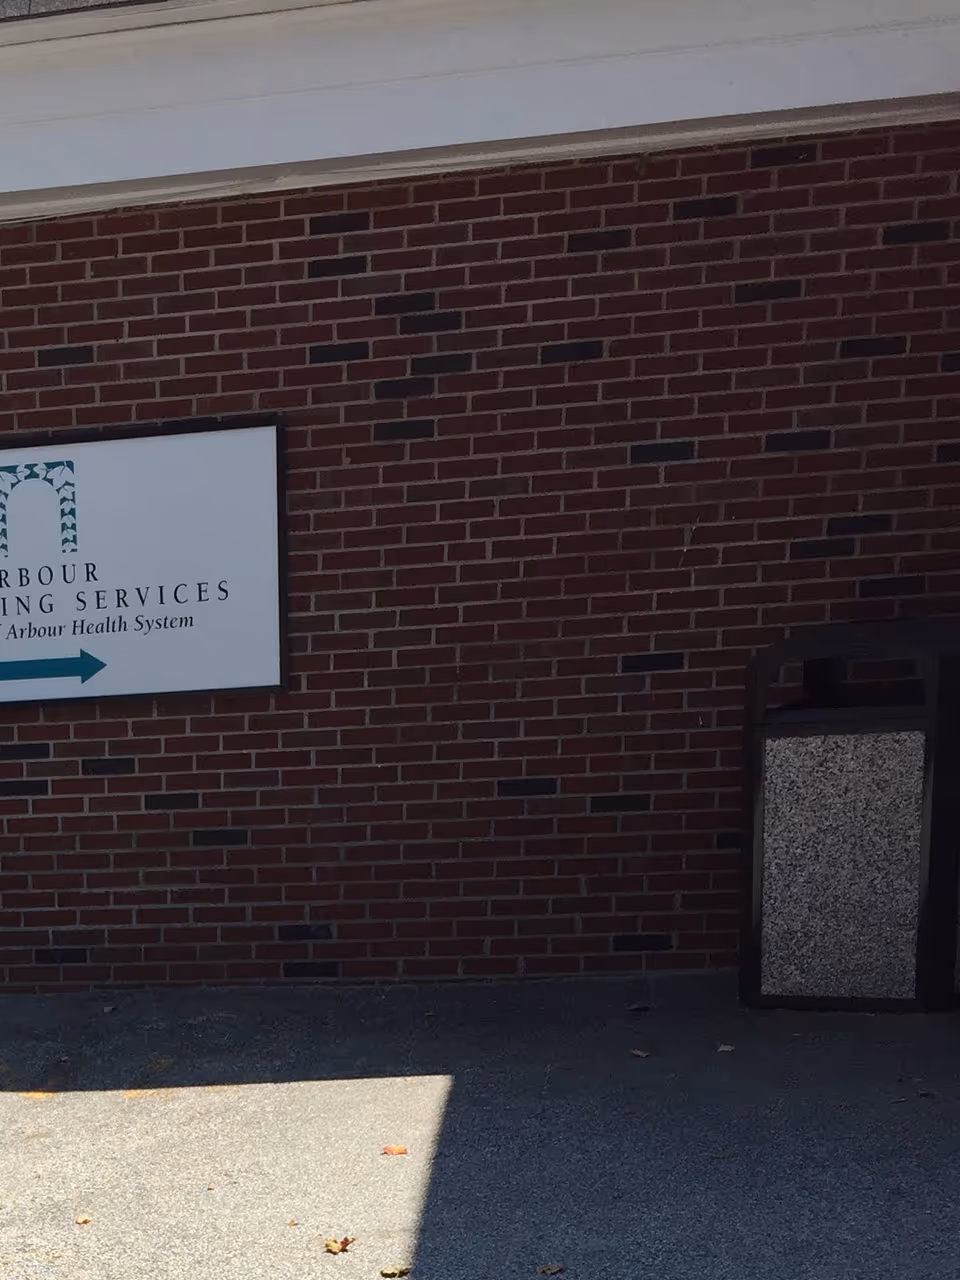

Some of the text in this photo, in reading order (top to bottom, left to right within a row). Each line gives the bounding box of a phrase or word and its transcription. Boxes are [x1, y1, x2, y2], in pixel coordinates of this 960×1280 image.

[75, 580, 229, 611] SERVICES
[5, 621, 67, 640] Arbour
[71, 615, 128, 636] Health
[133, 614, 194, 635] System
